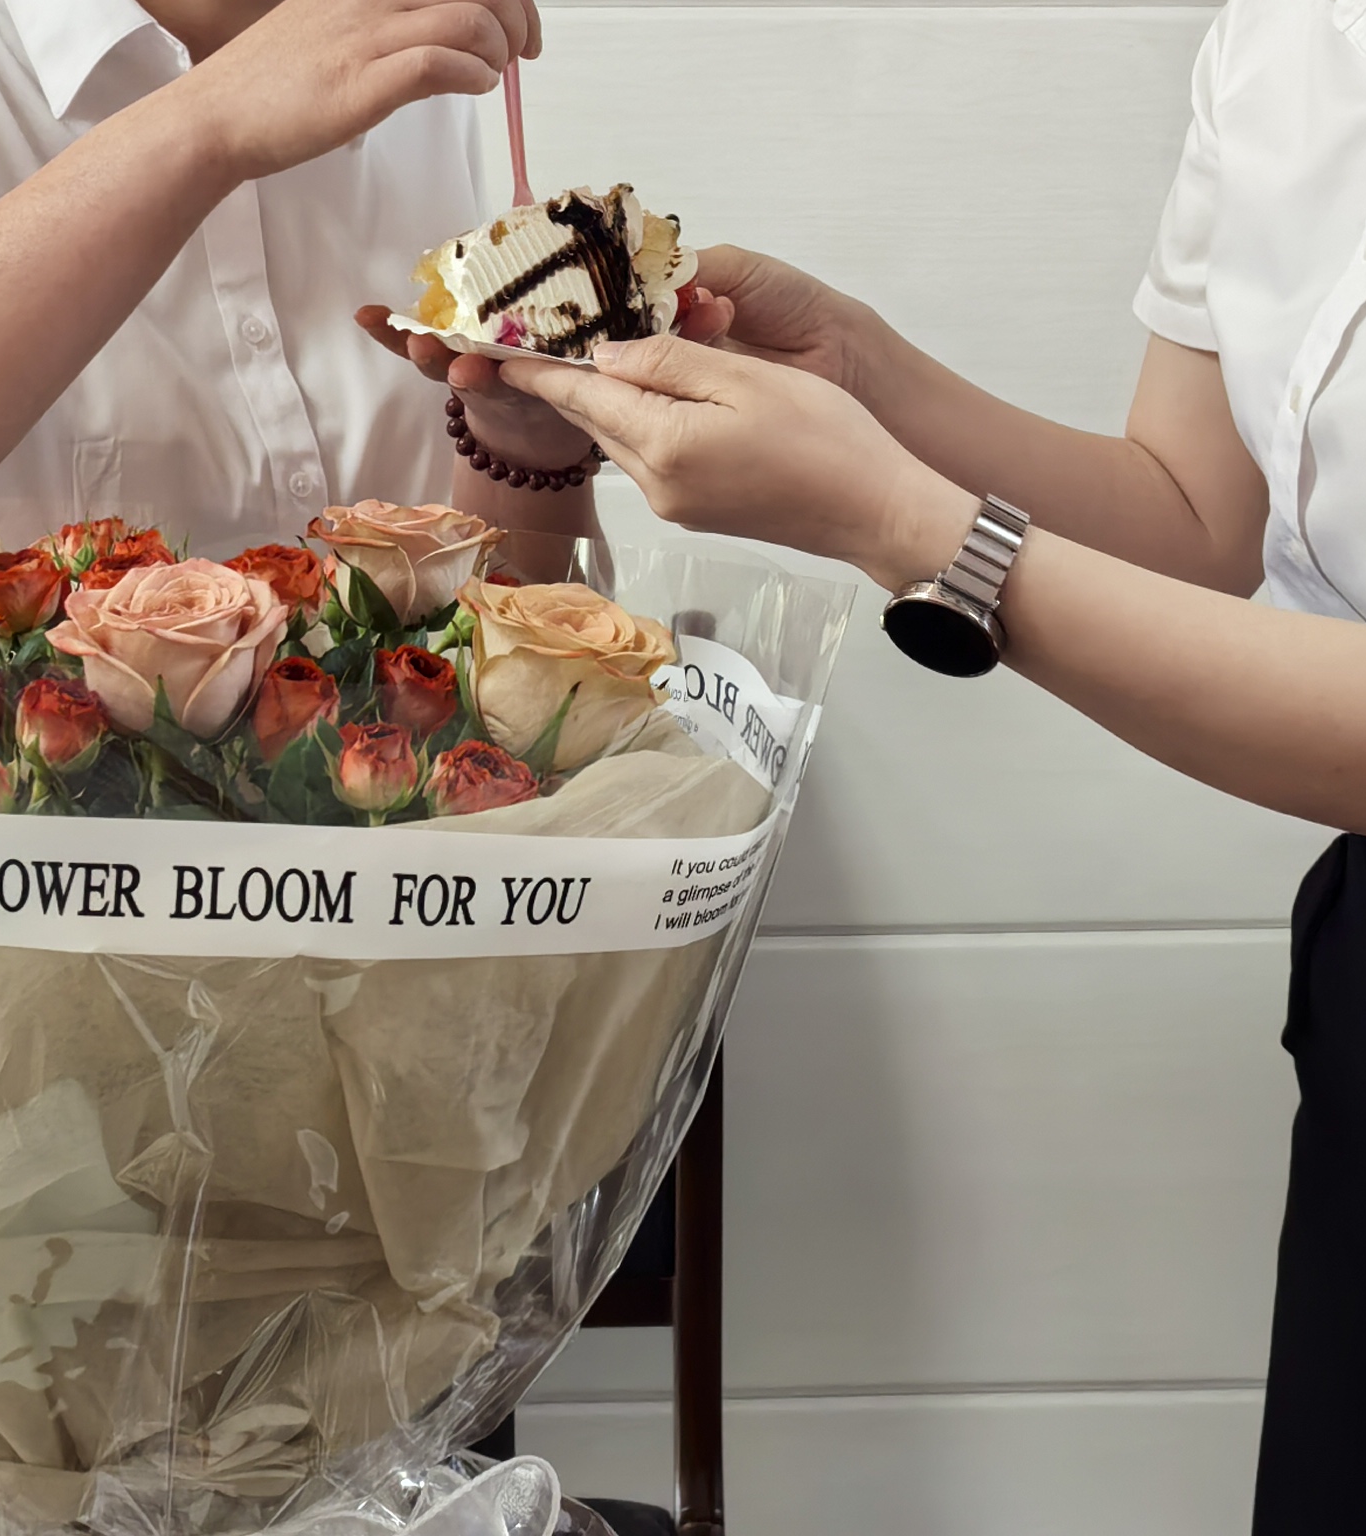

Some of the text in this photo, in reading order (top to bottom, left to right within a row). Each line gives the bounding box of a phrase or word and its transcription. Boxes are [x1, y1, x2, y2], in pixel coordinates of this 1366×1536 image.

[685, 860, 716, 879] you
[169, 865, 358, 924] BLOOM
[388, 873, 477, 927] FOR
[500, 877, 592, 926] YOU
[662, 889, 674, 903] a
[677, 880, 732, 906] glimpse
[654, 914, 661, 930] I
[665, 910, 692, 929] will
[693, 902, 728, 926] bloom
